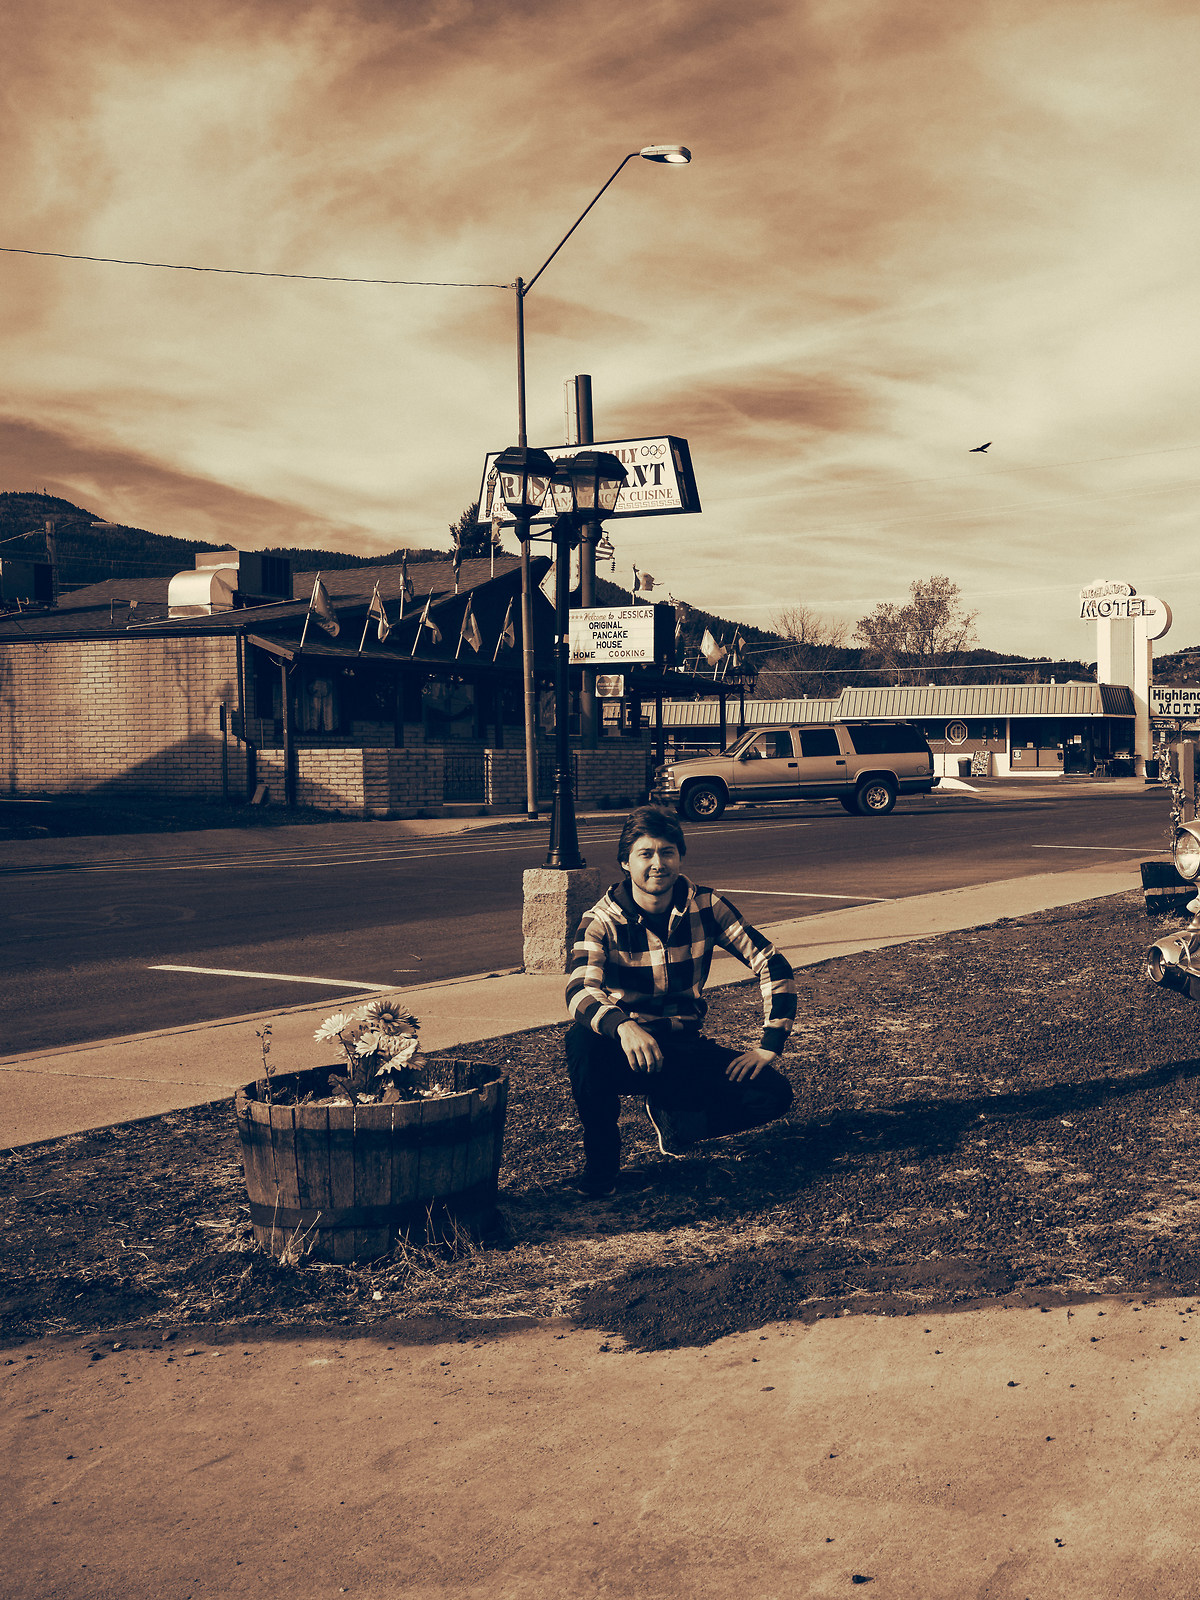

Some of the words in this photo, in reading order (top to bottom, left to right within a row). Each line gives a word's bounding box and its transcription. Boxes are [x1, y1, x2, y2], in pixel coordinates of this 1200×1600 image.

[629, 488, 673, 502] CUISINE
[1081, 583, 1128, 599] HIGHLANDER
[1080, 598, 1156, 618] MOTEL
[583, 612, 606, 621] Welcome
[608, 612, 614, 620] to
[588, 621, 623, 630] ORIGINAL
[592, 630, 629, 640] PANCAKE
[596, 640, 623, 649] HOUSE
[573, 651, 596, 659] HOME
[608, 649, 645, 658] COOKING
